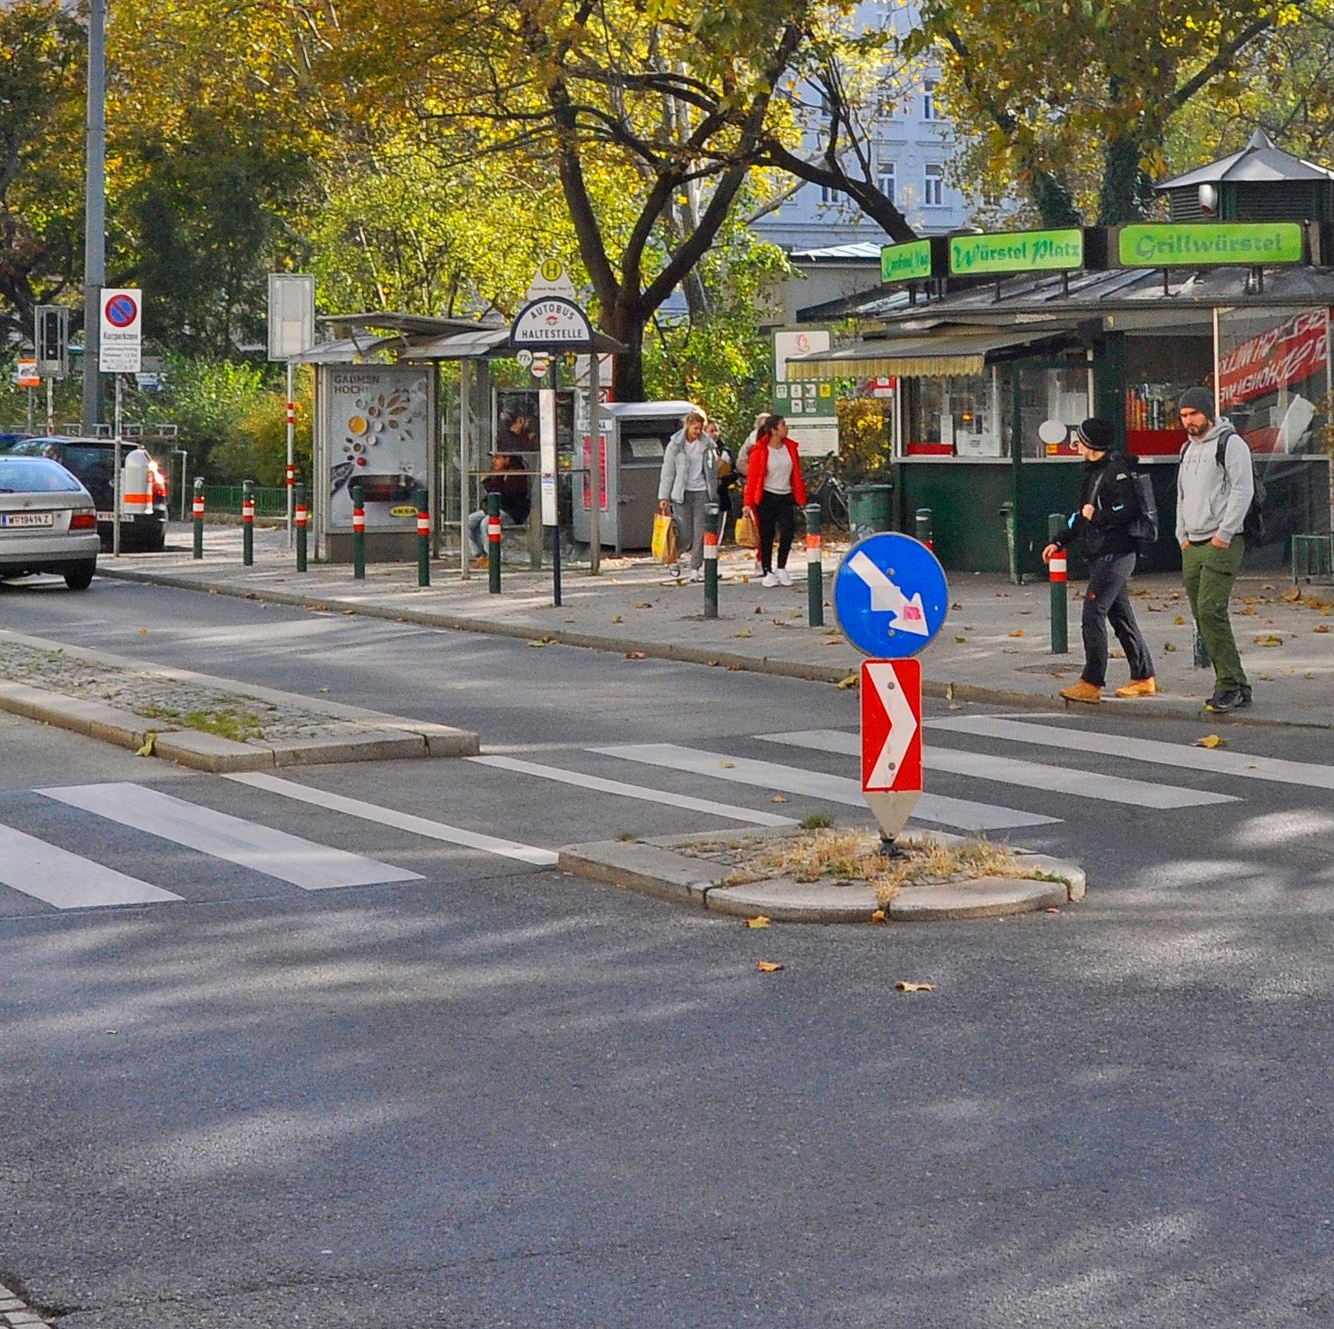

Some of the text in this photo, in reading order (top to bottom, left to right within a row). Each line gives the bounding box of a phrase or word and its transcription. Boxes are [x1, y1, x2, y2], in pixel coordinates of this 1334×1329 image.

[953, 239, 1080, 269] Würstel Platz
[1135, 233, 1282, 260] Grillwürstel
[530, 303, 575, 320] AUTOBUS
[522, 329, 582, 339] HALTESTELLE
[334, 375, 380, 384] GAUMEN
